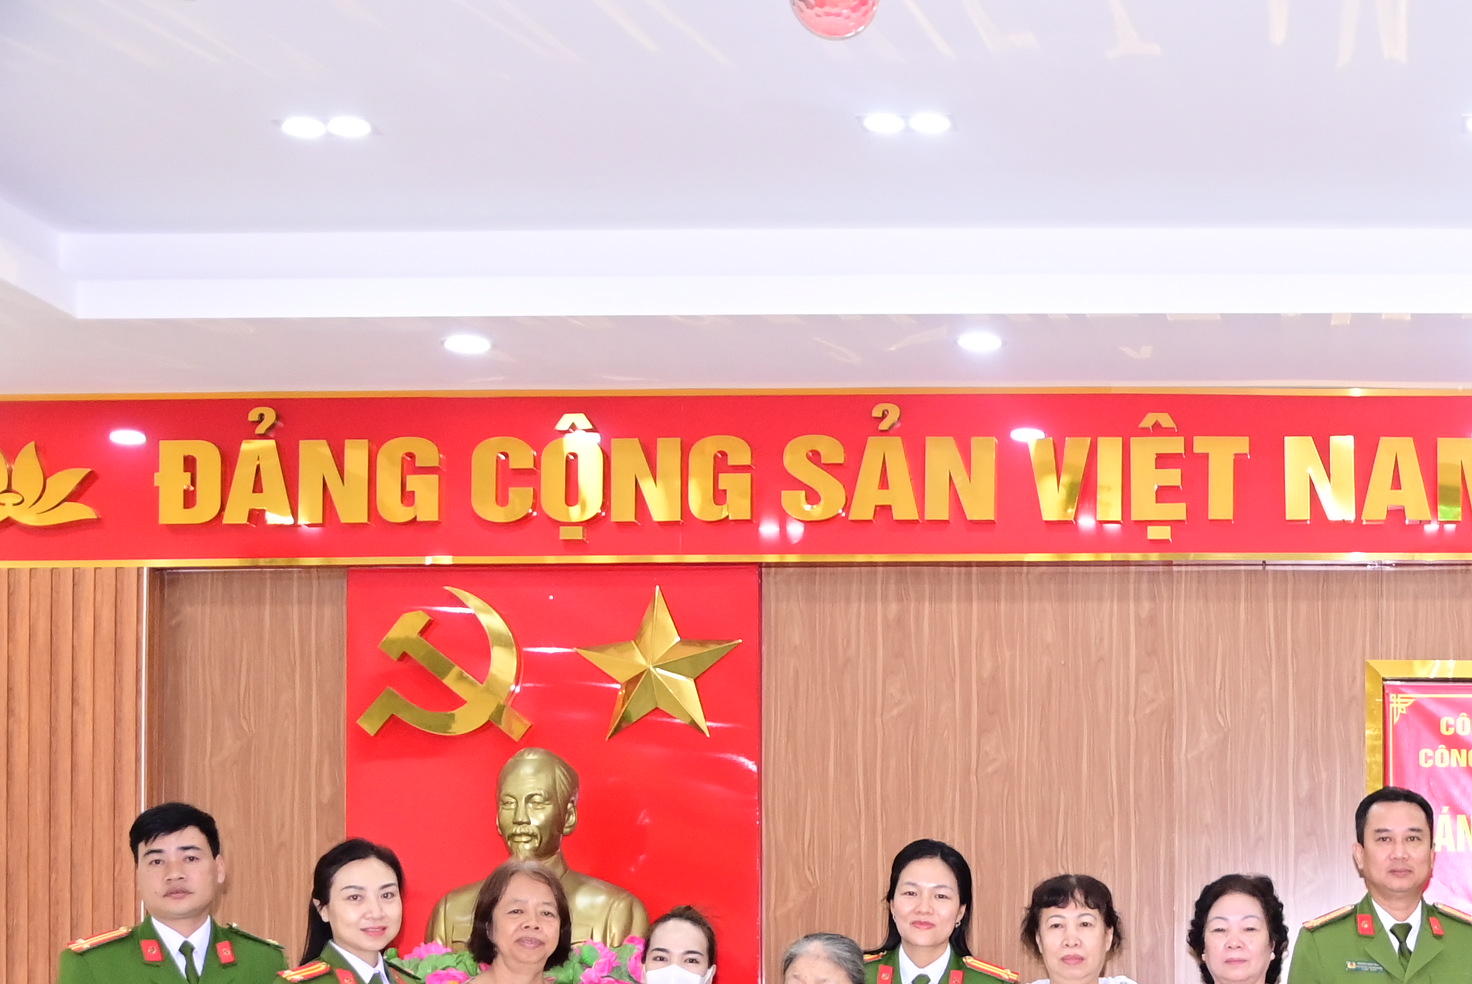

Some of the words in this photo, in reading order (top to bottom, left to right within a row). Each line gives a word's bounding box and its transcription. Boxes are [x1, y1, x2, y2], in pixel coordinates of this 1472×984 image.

[154, 406, 441, 526] ĐẢNG
[470, 412, 755, 541] CỘNG
[781, 403, 998, 523] SẢN
[1028, 412, 1249, 540] VIỆT
